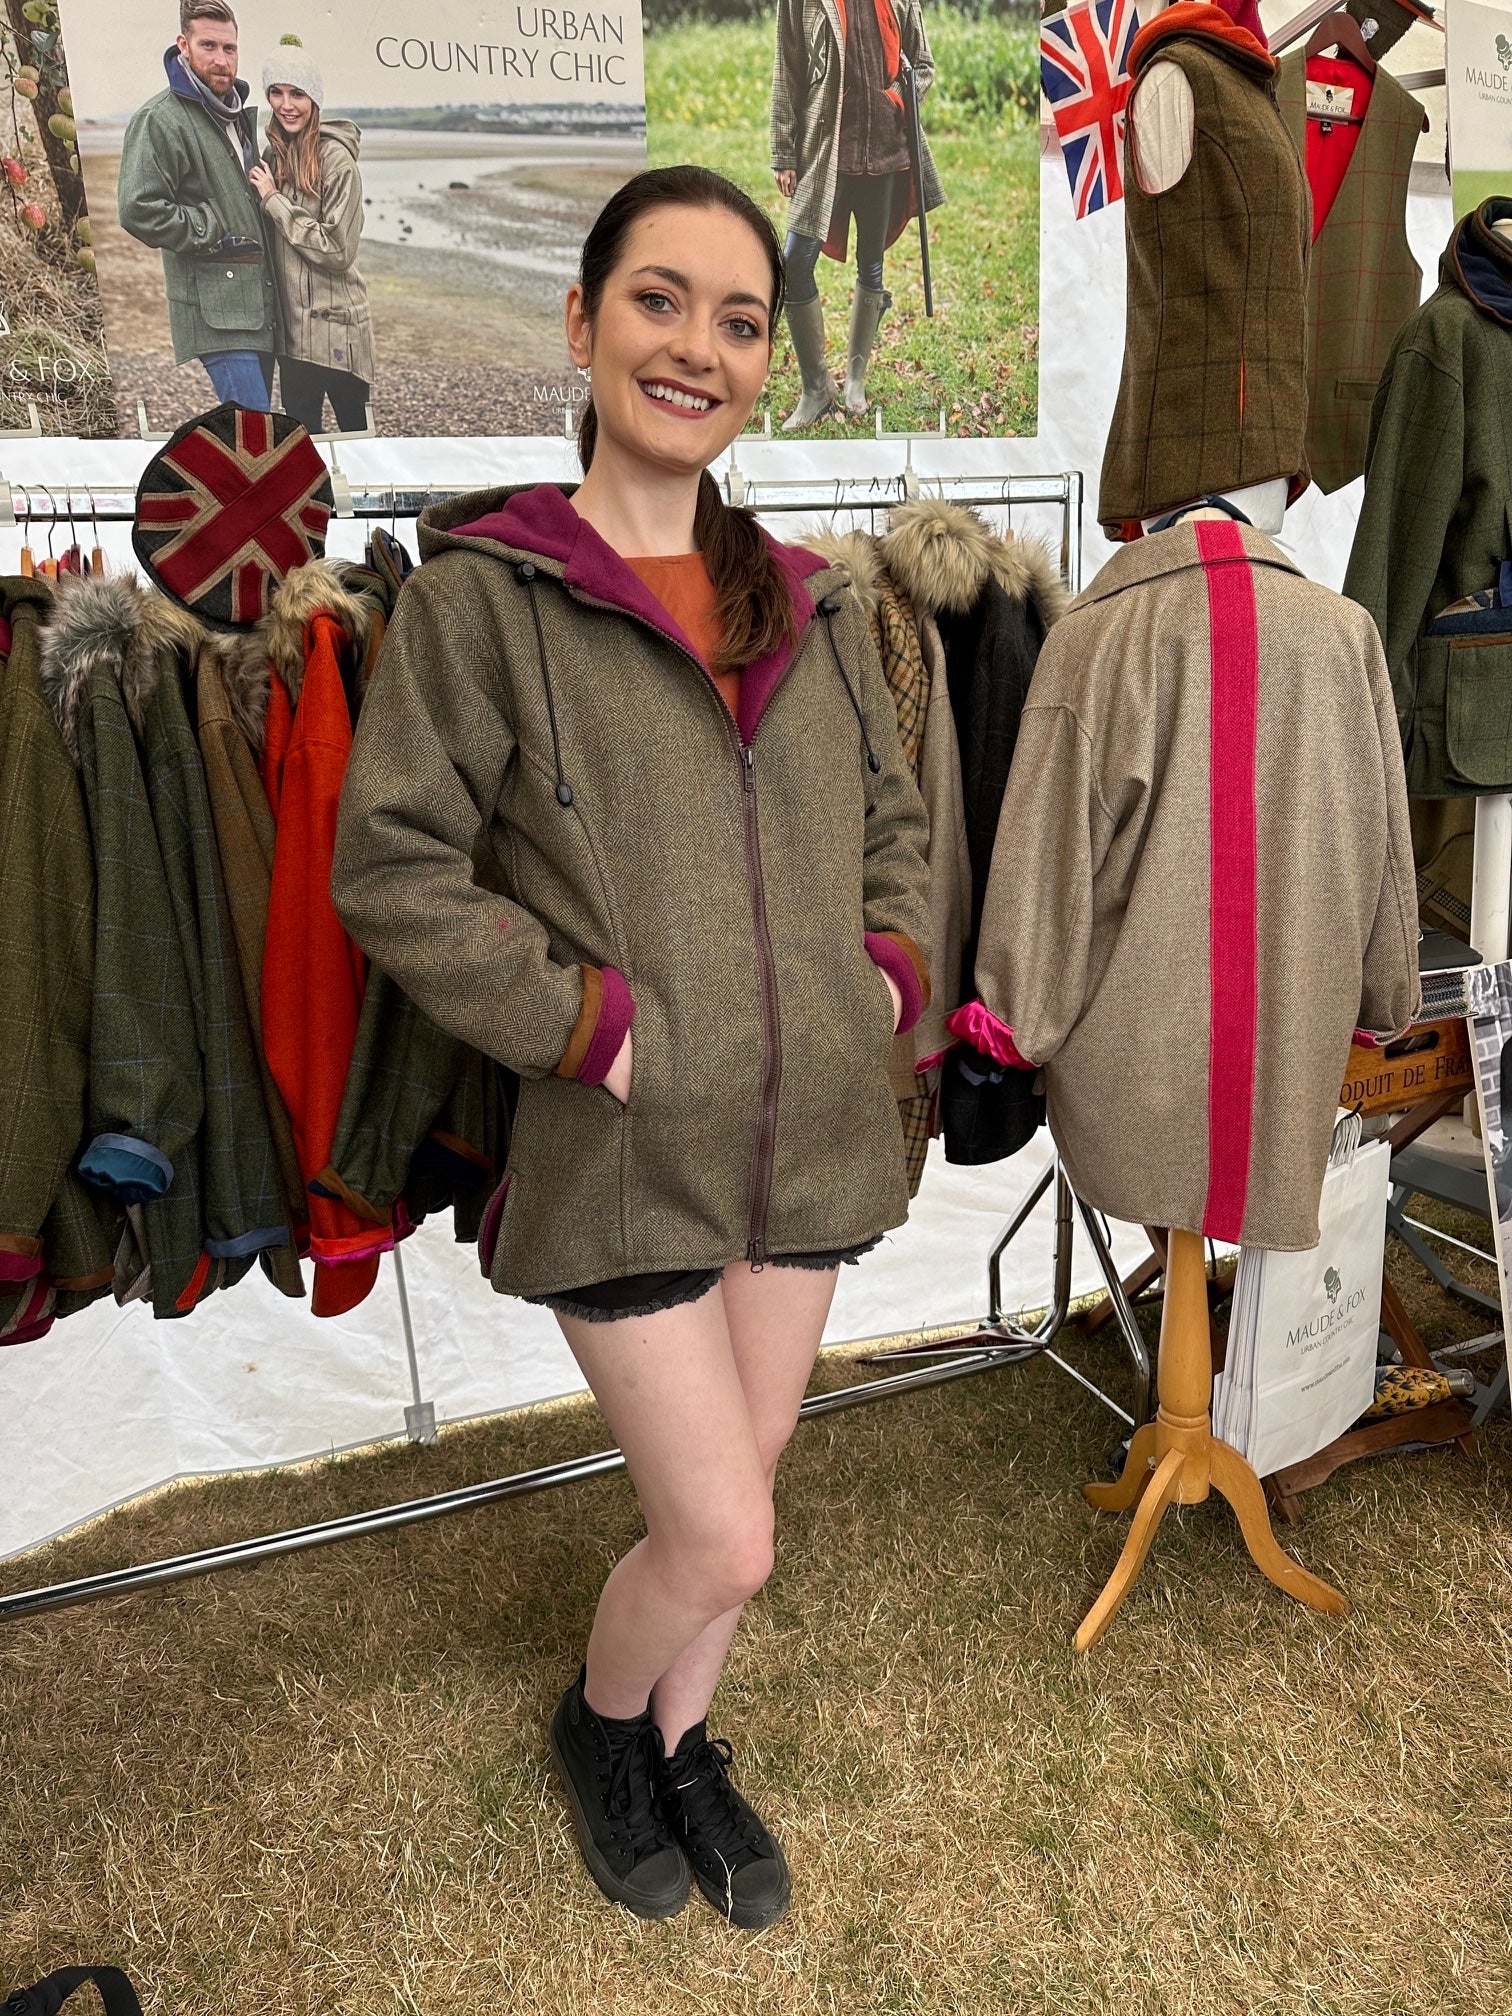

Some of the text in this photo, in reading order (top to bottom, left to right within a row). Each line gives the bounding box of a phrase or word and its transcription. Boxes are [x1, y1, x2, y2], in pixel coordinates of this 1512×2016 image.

[517, 6, 623, 45] URBAN
[376, 36, 626, 85] COUNTRY CHIC
[1465, 66, 1508, 91] MAUDE
[1309, 101, 1330, 112] MAUDE
[9, 356, 95, 382] & FOX
[533, 385, 591, 402] MAUDE
[1340, 1072, 1395, 1104] ODUIT
[1403, 1064, 1425, 1088] DE
[1286, 1286, 1367, 1349] MAUDE & FOX
[1301, 1341, 1322, 1355] URBAN
